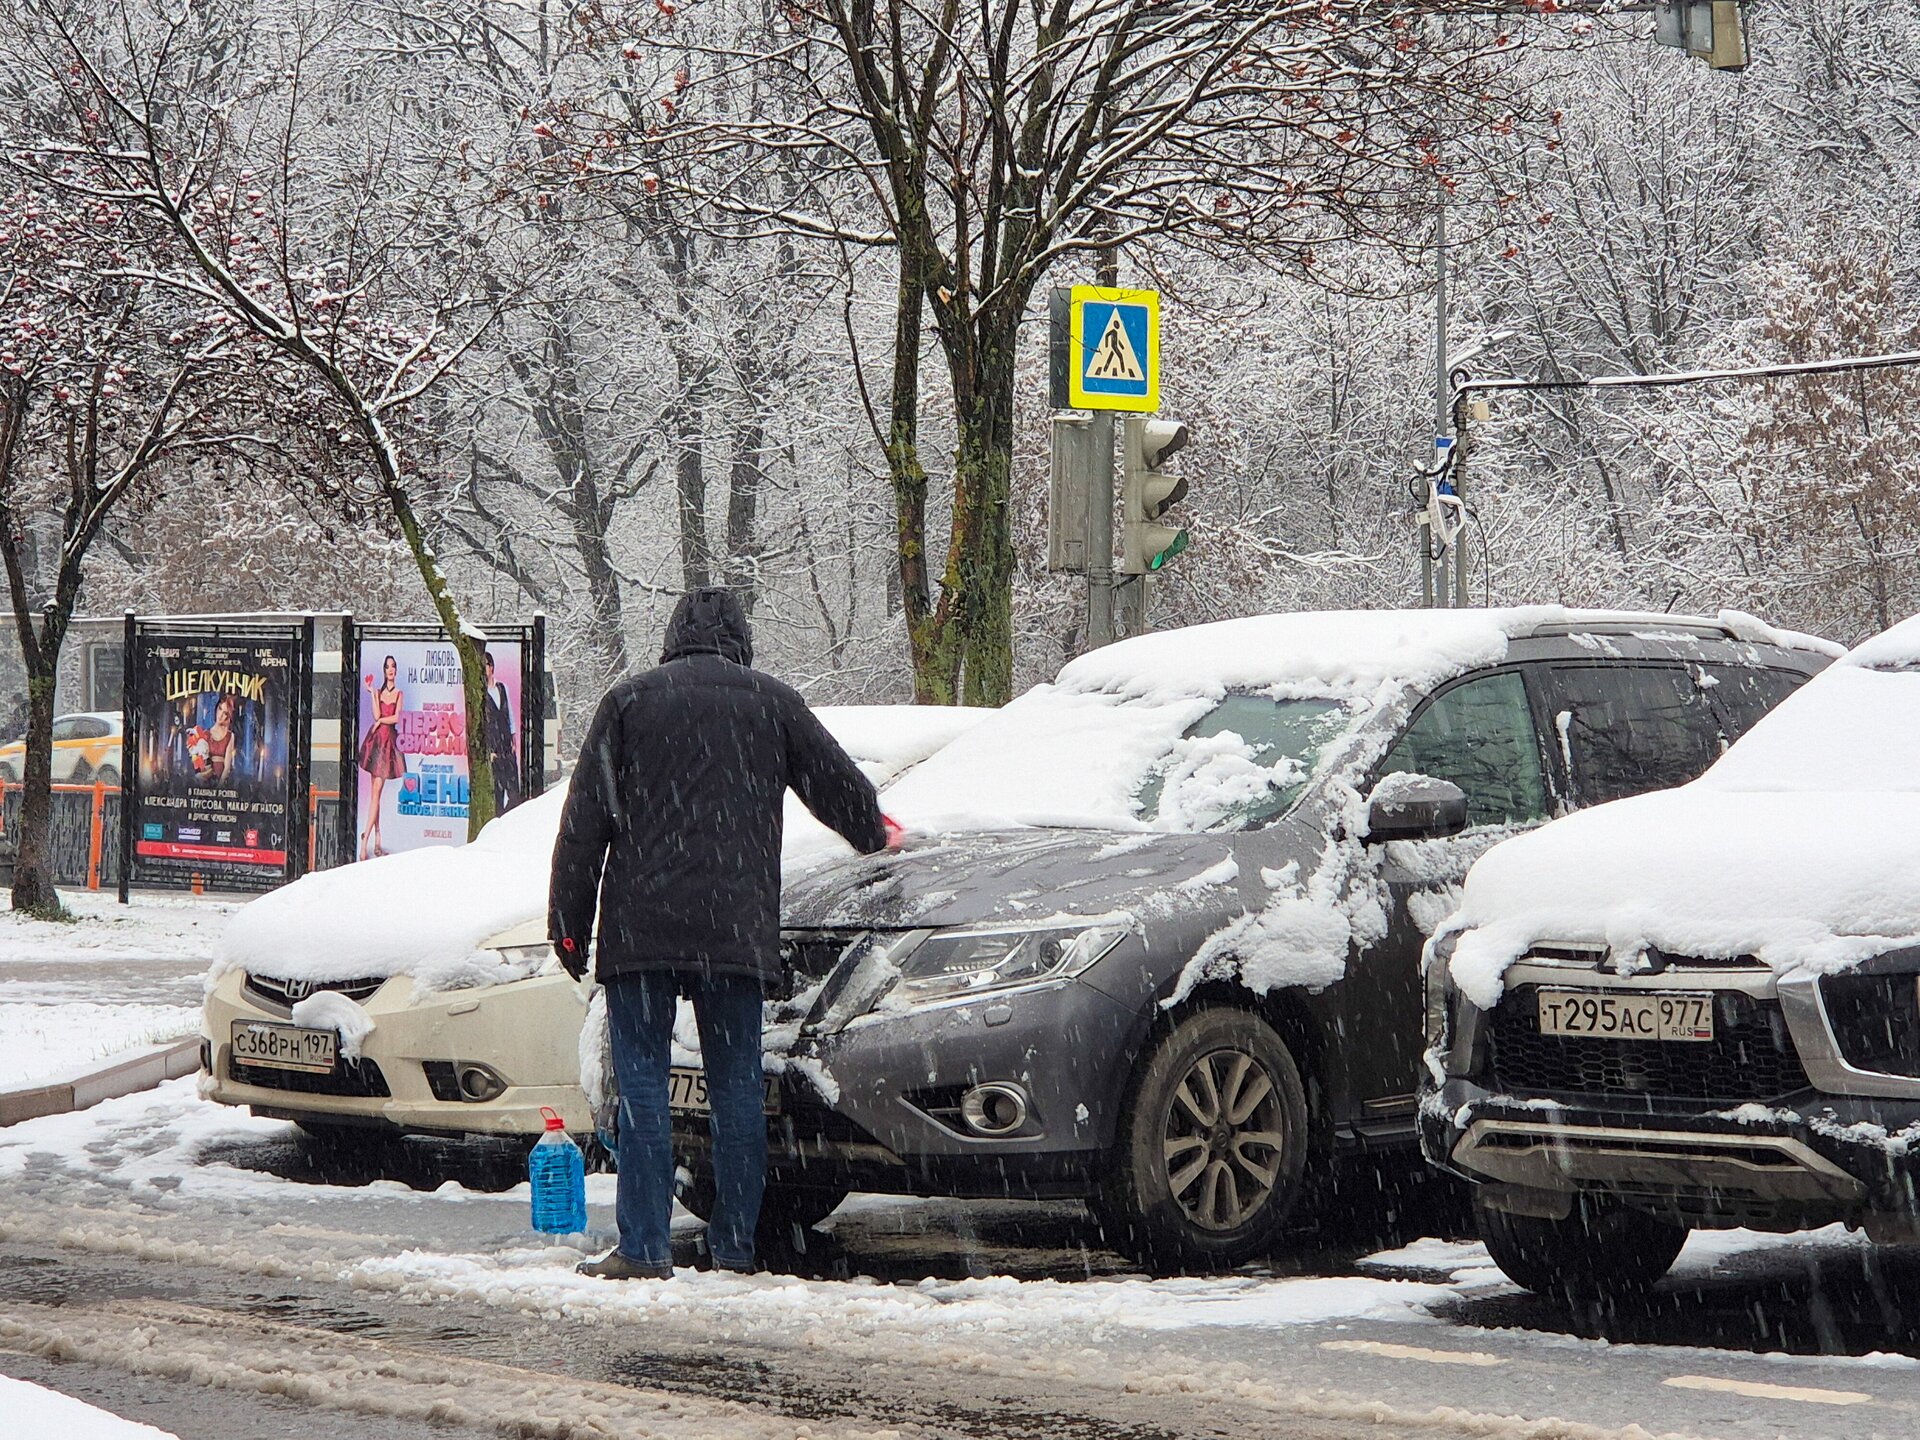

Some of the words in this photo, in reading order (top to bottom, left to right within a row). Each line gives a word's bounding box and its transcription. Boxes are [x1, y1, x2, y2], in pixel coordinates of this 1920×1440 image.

[255, 648, 272, 658] LIVE
[425, 650, 455, 667] ЛЮБОВЬ
[261, 658, 288, 667] АРЕНА
[408, 668, 418, 684] НА
[420, 669, 445, 685] САМОМ
[166, 668, 267, 705] ЩЕЛКУНЧИК
[144, 796, 187, 808] АЛЕКСАНДРА
[190, 799, 224, 811] ТРУСОВА,
[227, 801, 249, 812] МАКАР
[252, 803, 284, 815] ИГНАТОВ
[271, 833, 282, 846] 0+
[1548, 998, 1653, 1034] Т295АС
[1660, 1000, 1704, 1026] 977
[1671, 1026, 1693, 1037] RUS
[236, 1030, 300, 1059] С368РН
[304, 1034, 329, 1054] 197
